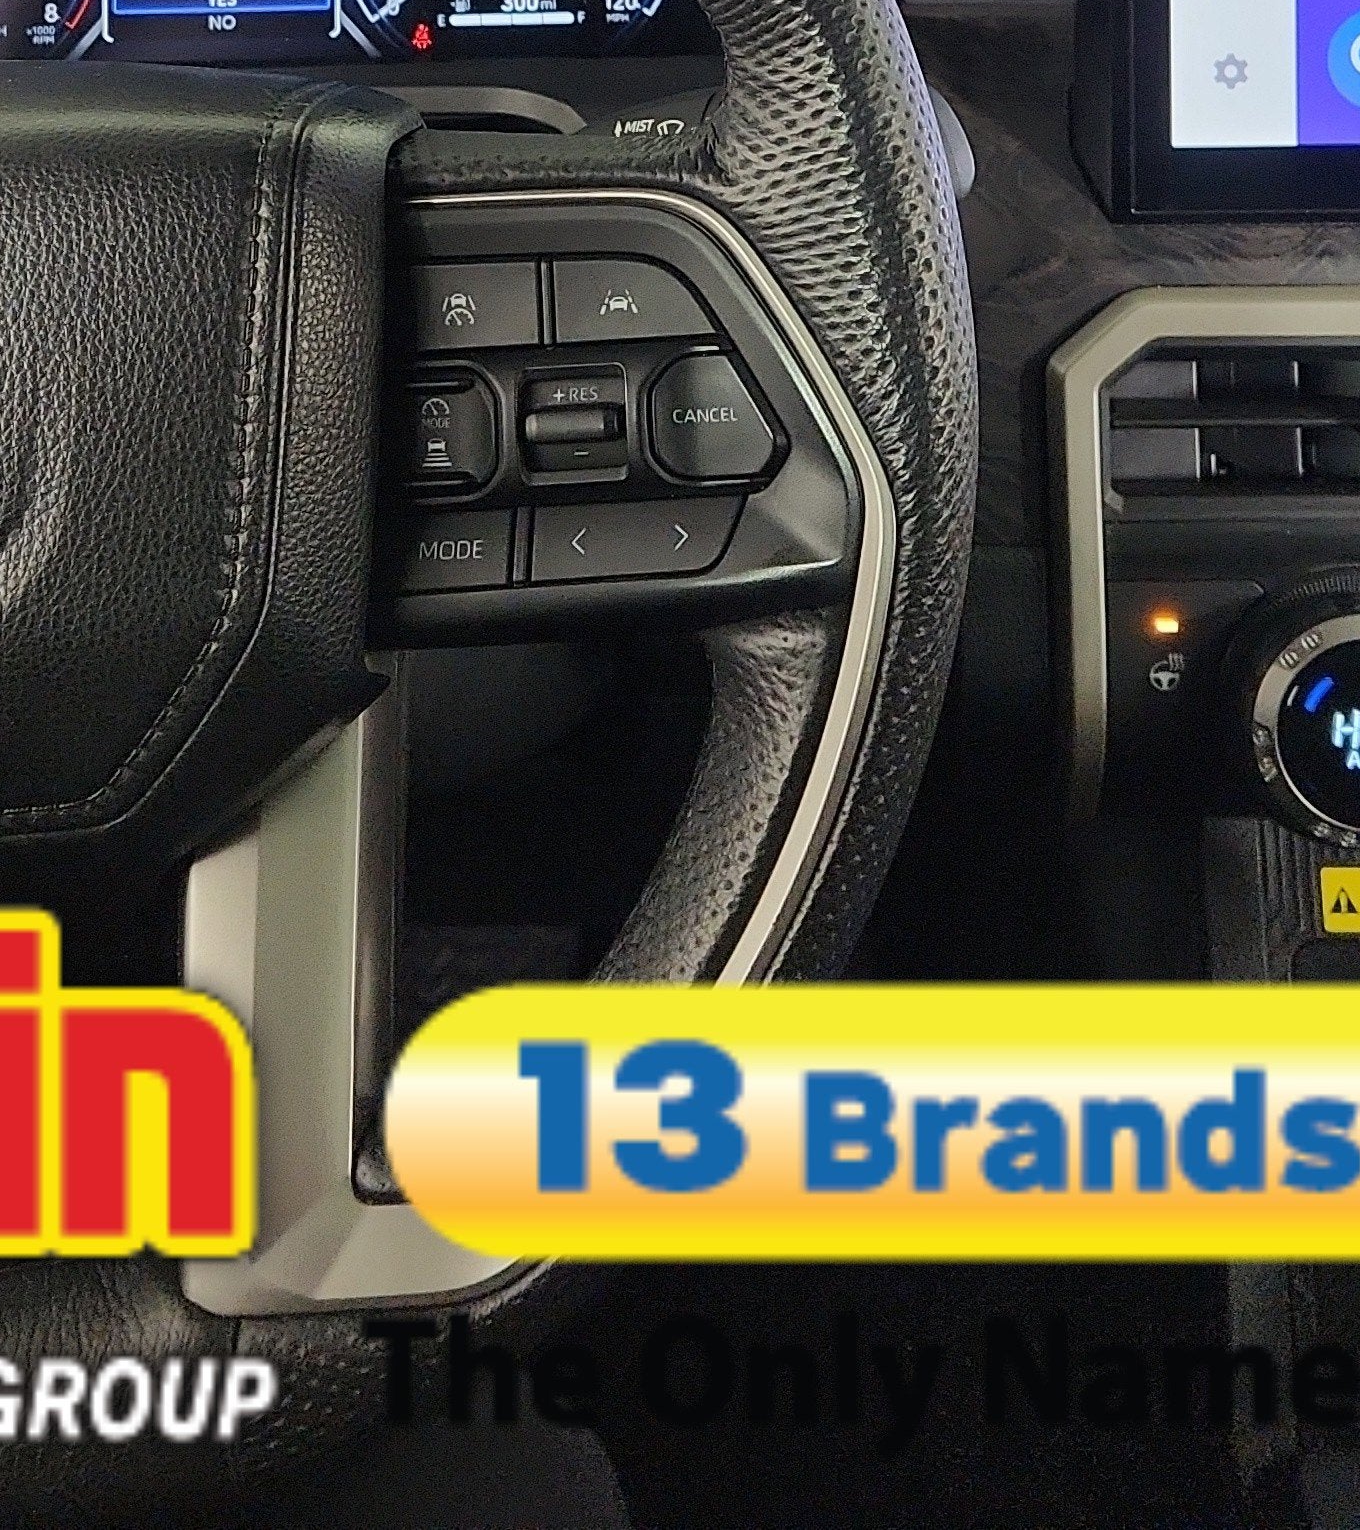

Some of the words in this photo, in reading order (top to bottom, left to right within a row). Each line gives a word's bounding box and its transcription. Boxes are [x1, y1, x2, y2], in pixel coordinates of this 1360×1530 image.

[43, 2, 59, 24] 8
[207, 13, 237, 32] NO
[437, 13, 447, 28] E
[577, 10, 586, 25] F
[623, 119, 656, 135] MIST
[672, 406, 738, 425] CANCEL
[419, 539, 484, 561] MODE
